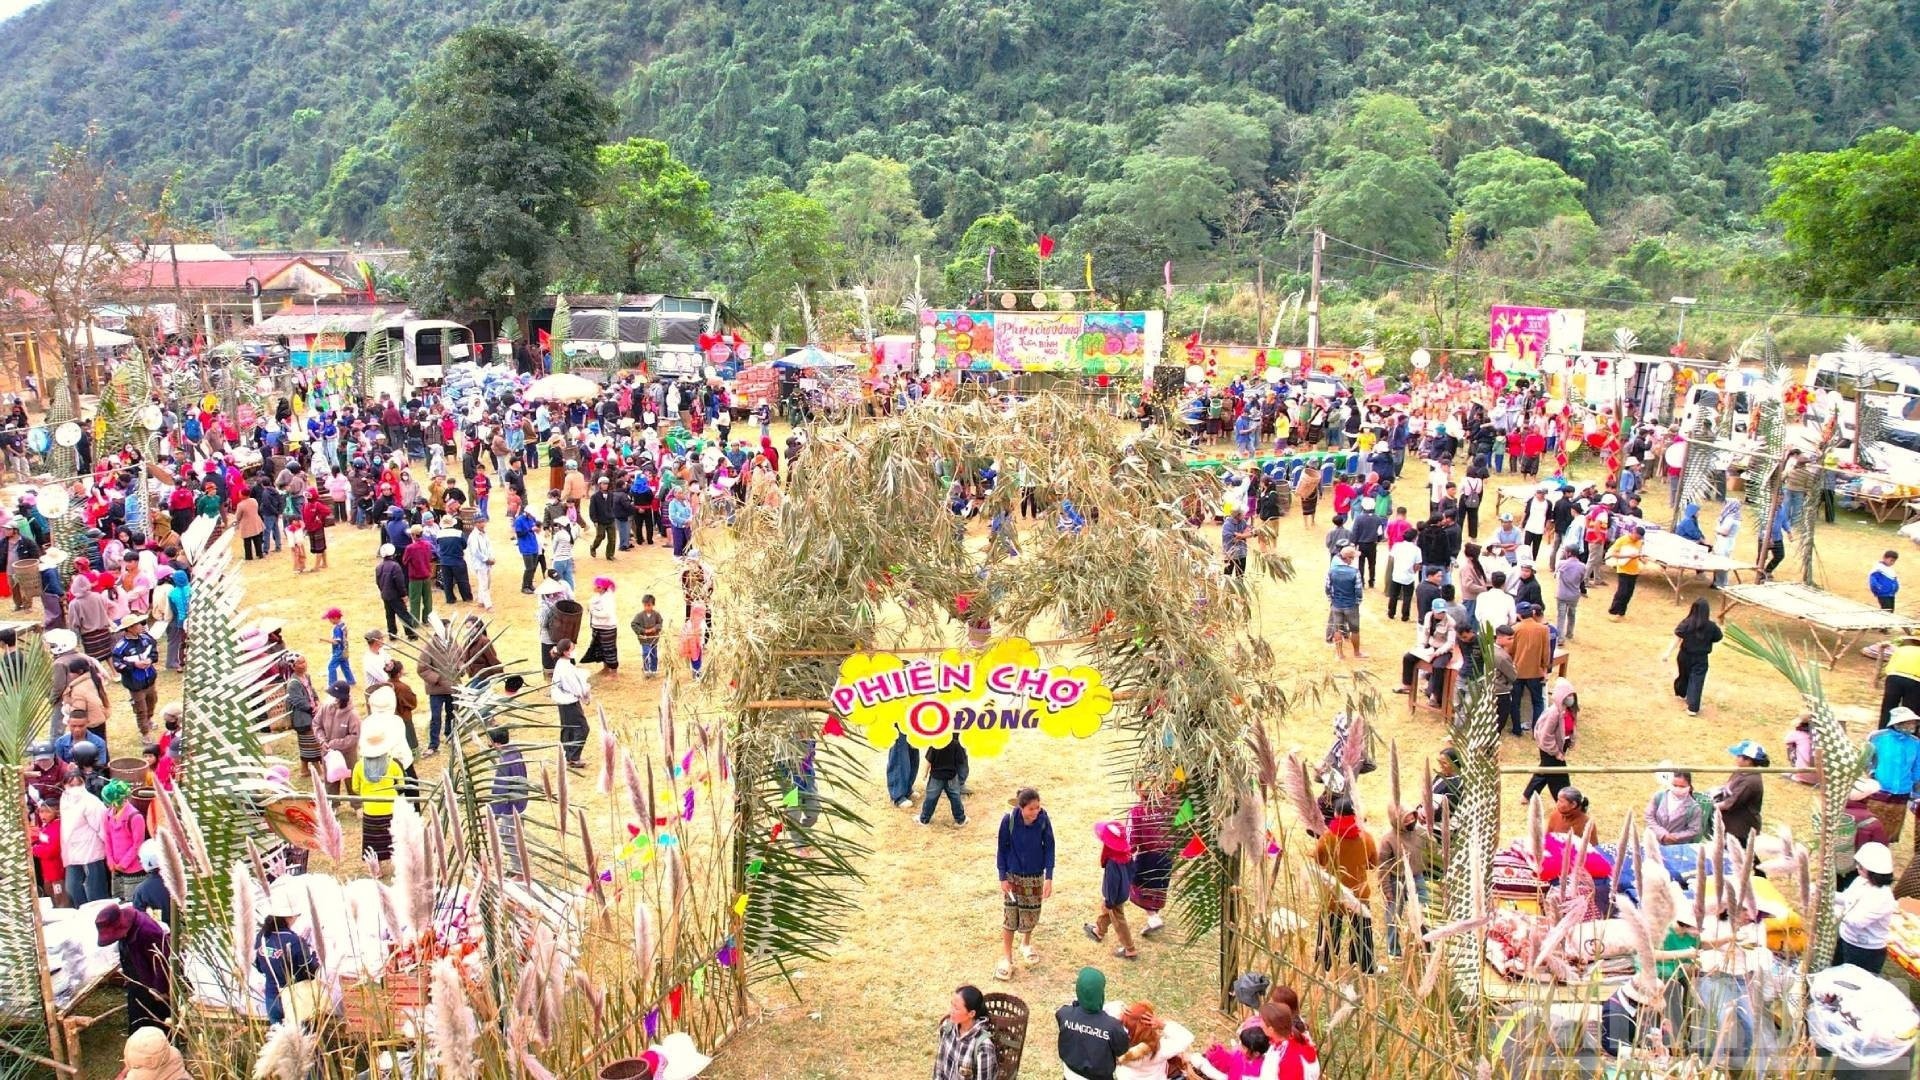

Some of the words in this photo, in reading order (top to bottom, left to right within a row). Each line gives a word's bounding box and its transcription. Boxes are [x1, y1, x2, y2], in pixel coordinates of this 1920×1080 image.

[833, 662, 970, 712] PHIÊN
[991, 665, 1085, 711] CHỢ
[952, 699, 1040, 731] ĐỒNG
